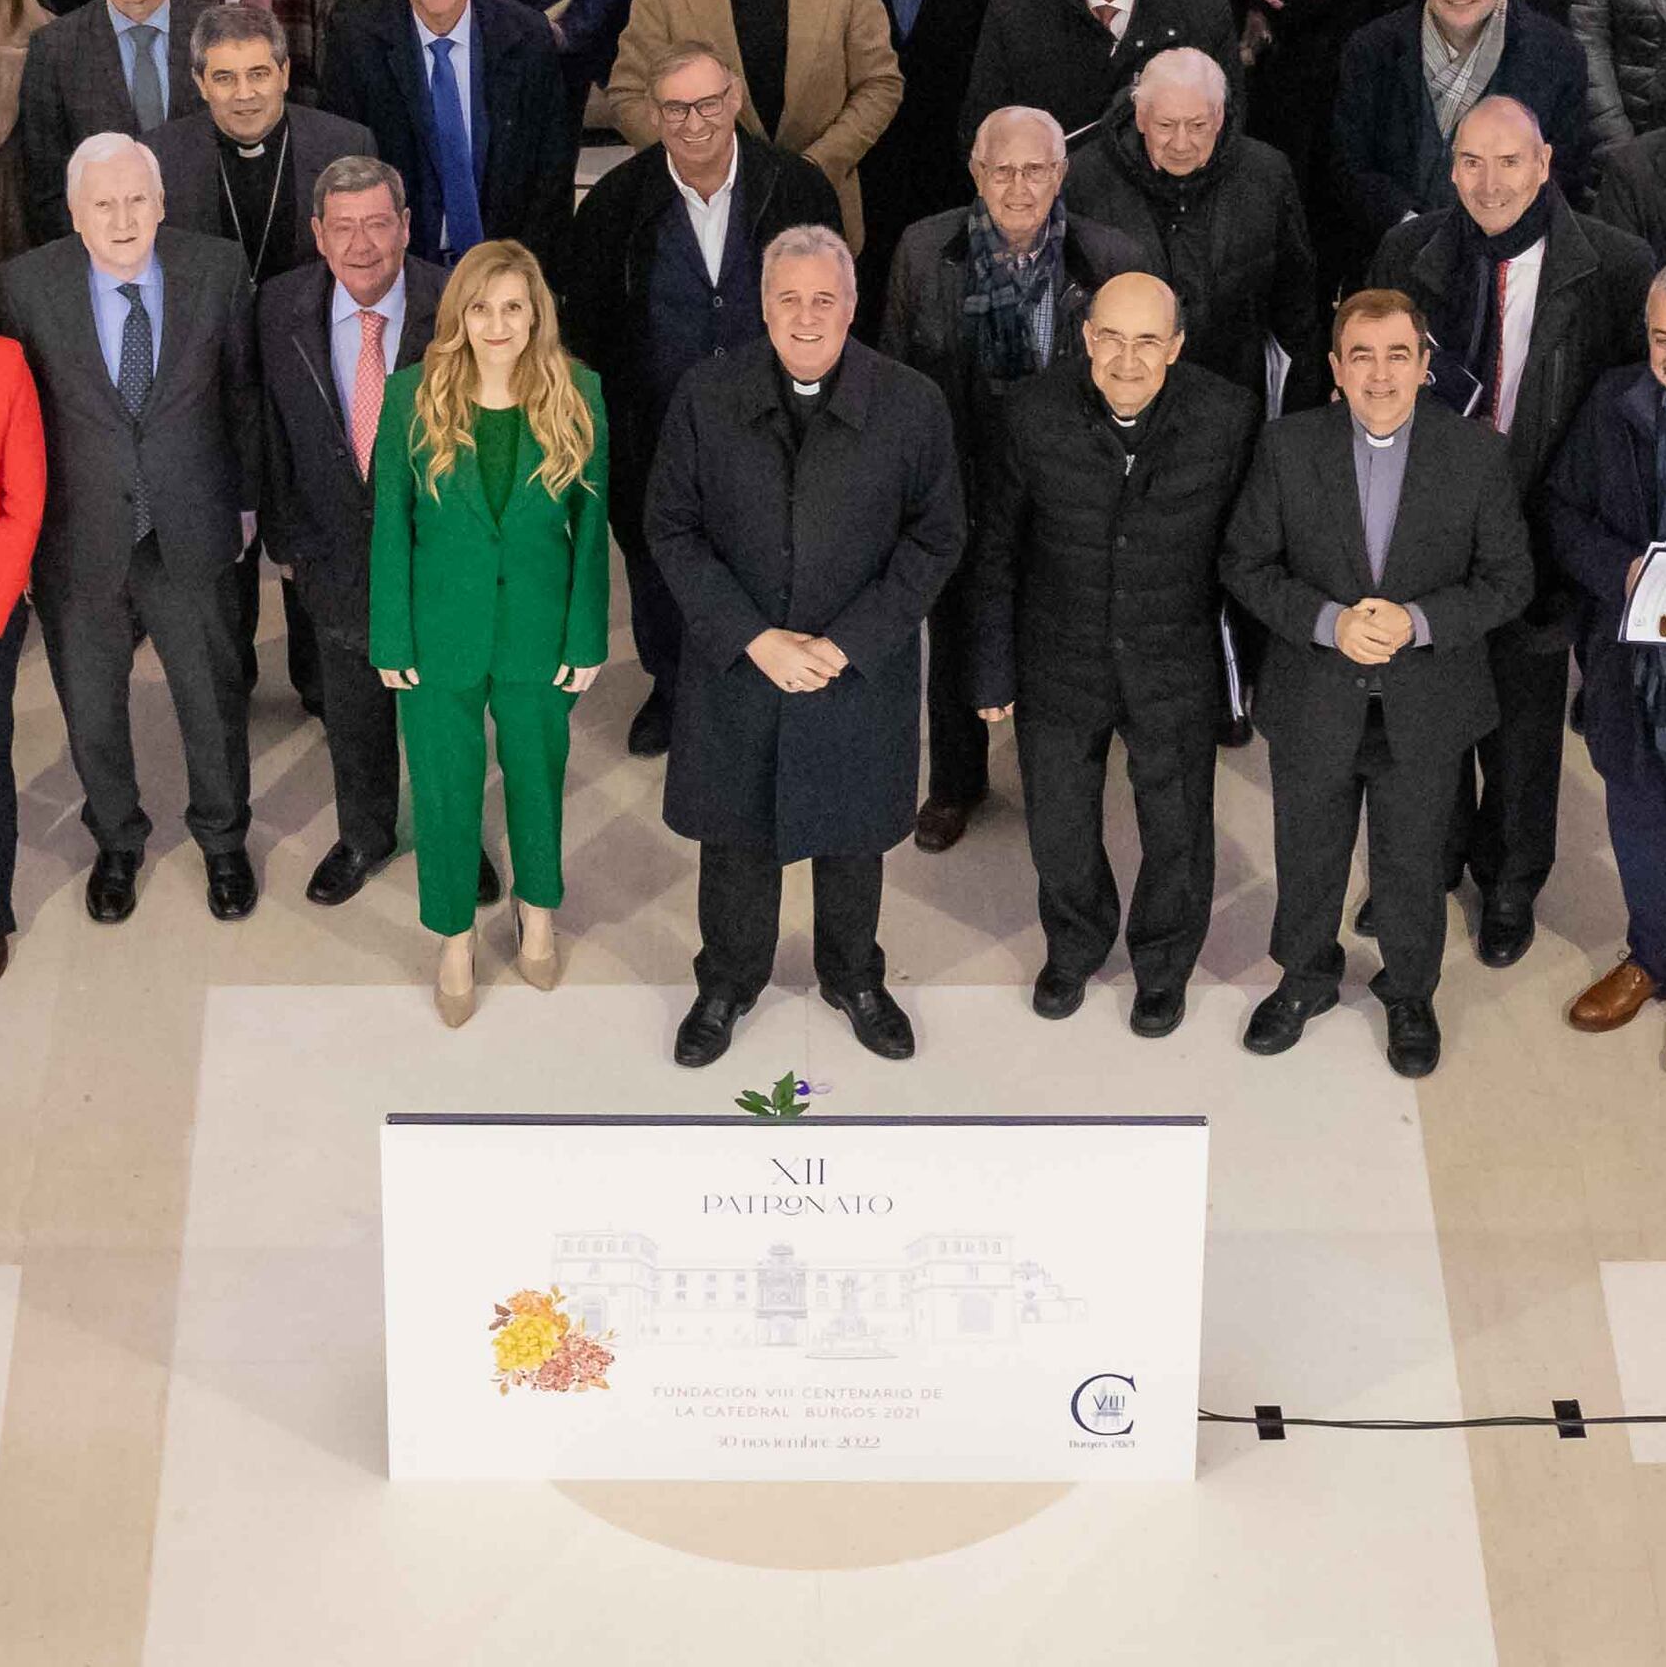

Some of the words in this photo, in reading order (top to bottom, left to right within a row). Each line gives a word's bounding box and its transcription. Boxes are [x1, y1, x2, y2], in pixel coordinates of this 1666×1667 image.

[770, 1157, 825, 1185] XII
[702, 1193, 894, 1216] PATRONATO
[765, 1387, 795, 1398] VIII
[801, 1387, 913, 1399] CENTENARIO
[920, 1387, 943, 1399] DE
[674, 1406, 695, 1418] LA
[804, 1406, 877, 1419] BURGOS
[883, 1407, 921, 1419] 2021
[717, 1434, 738, 1449] 30
[741, 1433, 831, 1449] noviembre
[836, 1435, 882, 1449] 2022
